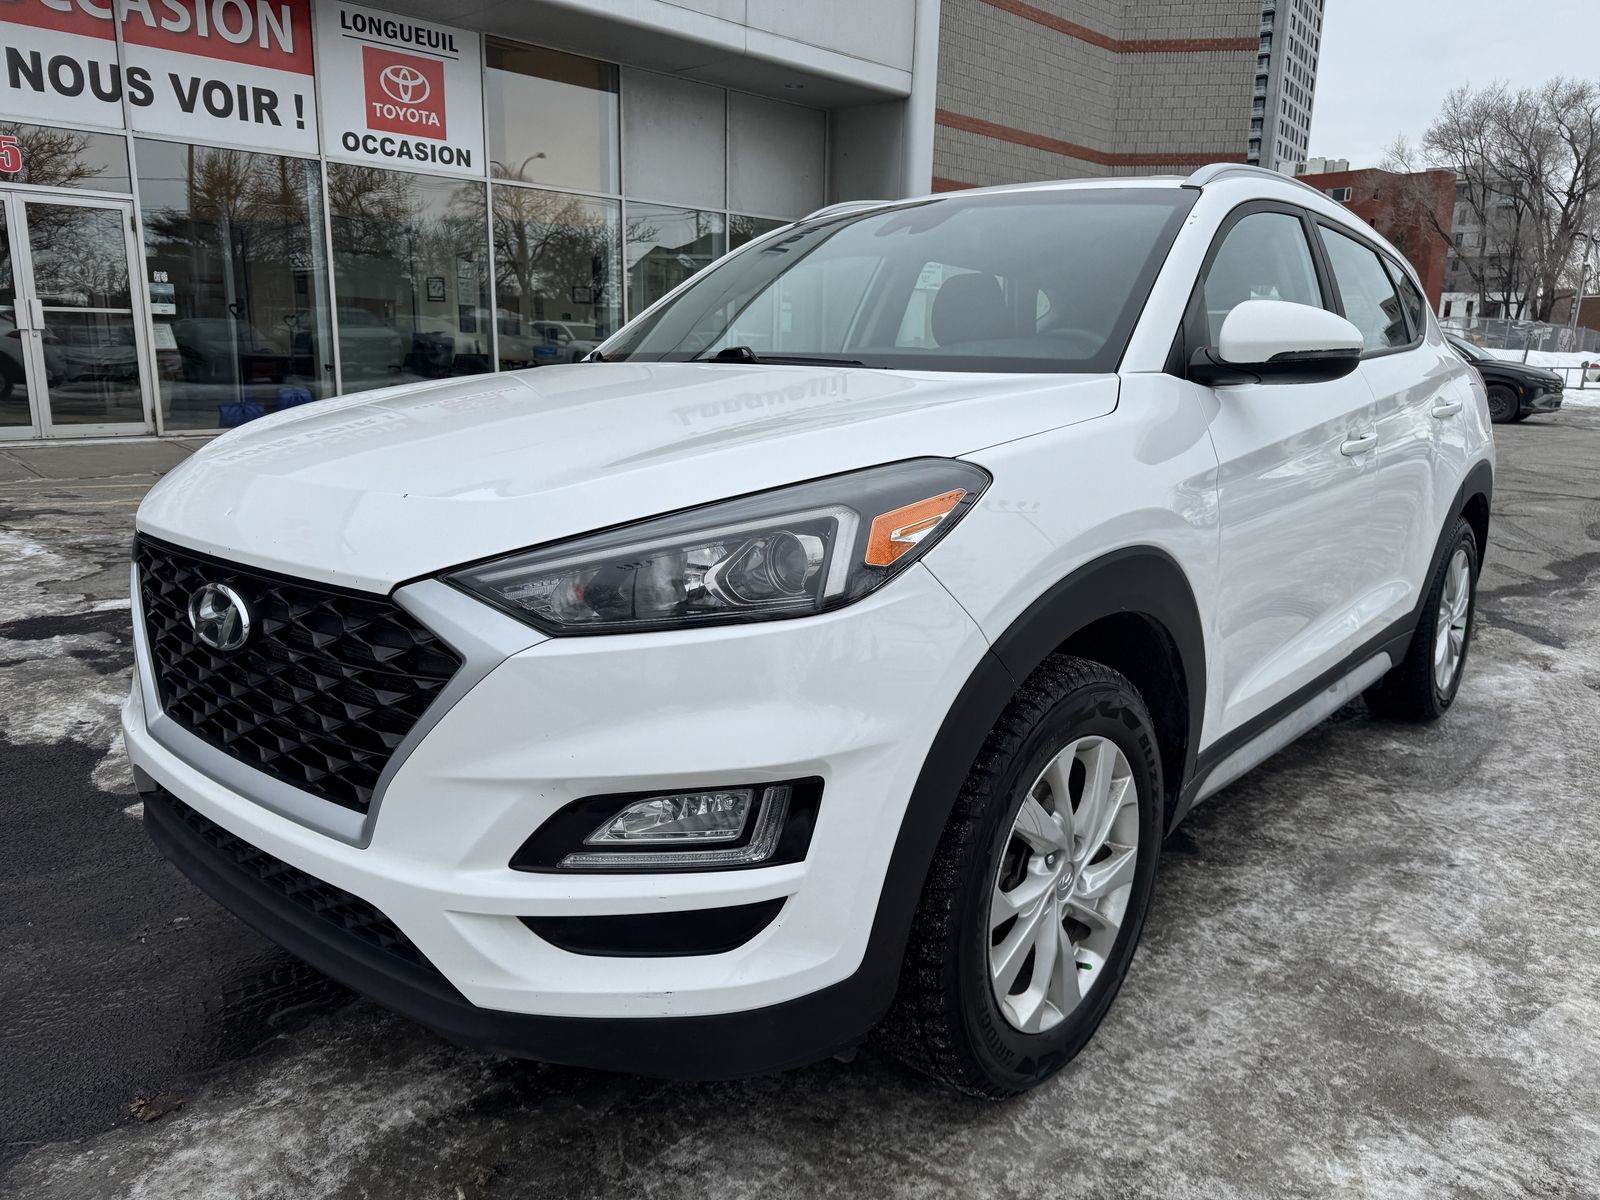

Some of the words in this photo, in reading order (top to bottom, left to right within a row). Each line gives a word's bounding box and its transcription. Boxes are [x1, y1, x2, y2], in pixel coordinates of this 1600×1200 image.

[340, 10, 459, 53] LONGUEUIL
[5, 46, 154, 107] NOUS
[168, 72, 282, 127] VOIR
[372, 102, 440, 127] TOYOTA
[0, 135, 22, 172] 5
[342, 131, 471, 168] OCCASION
